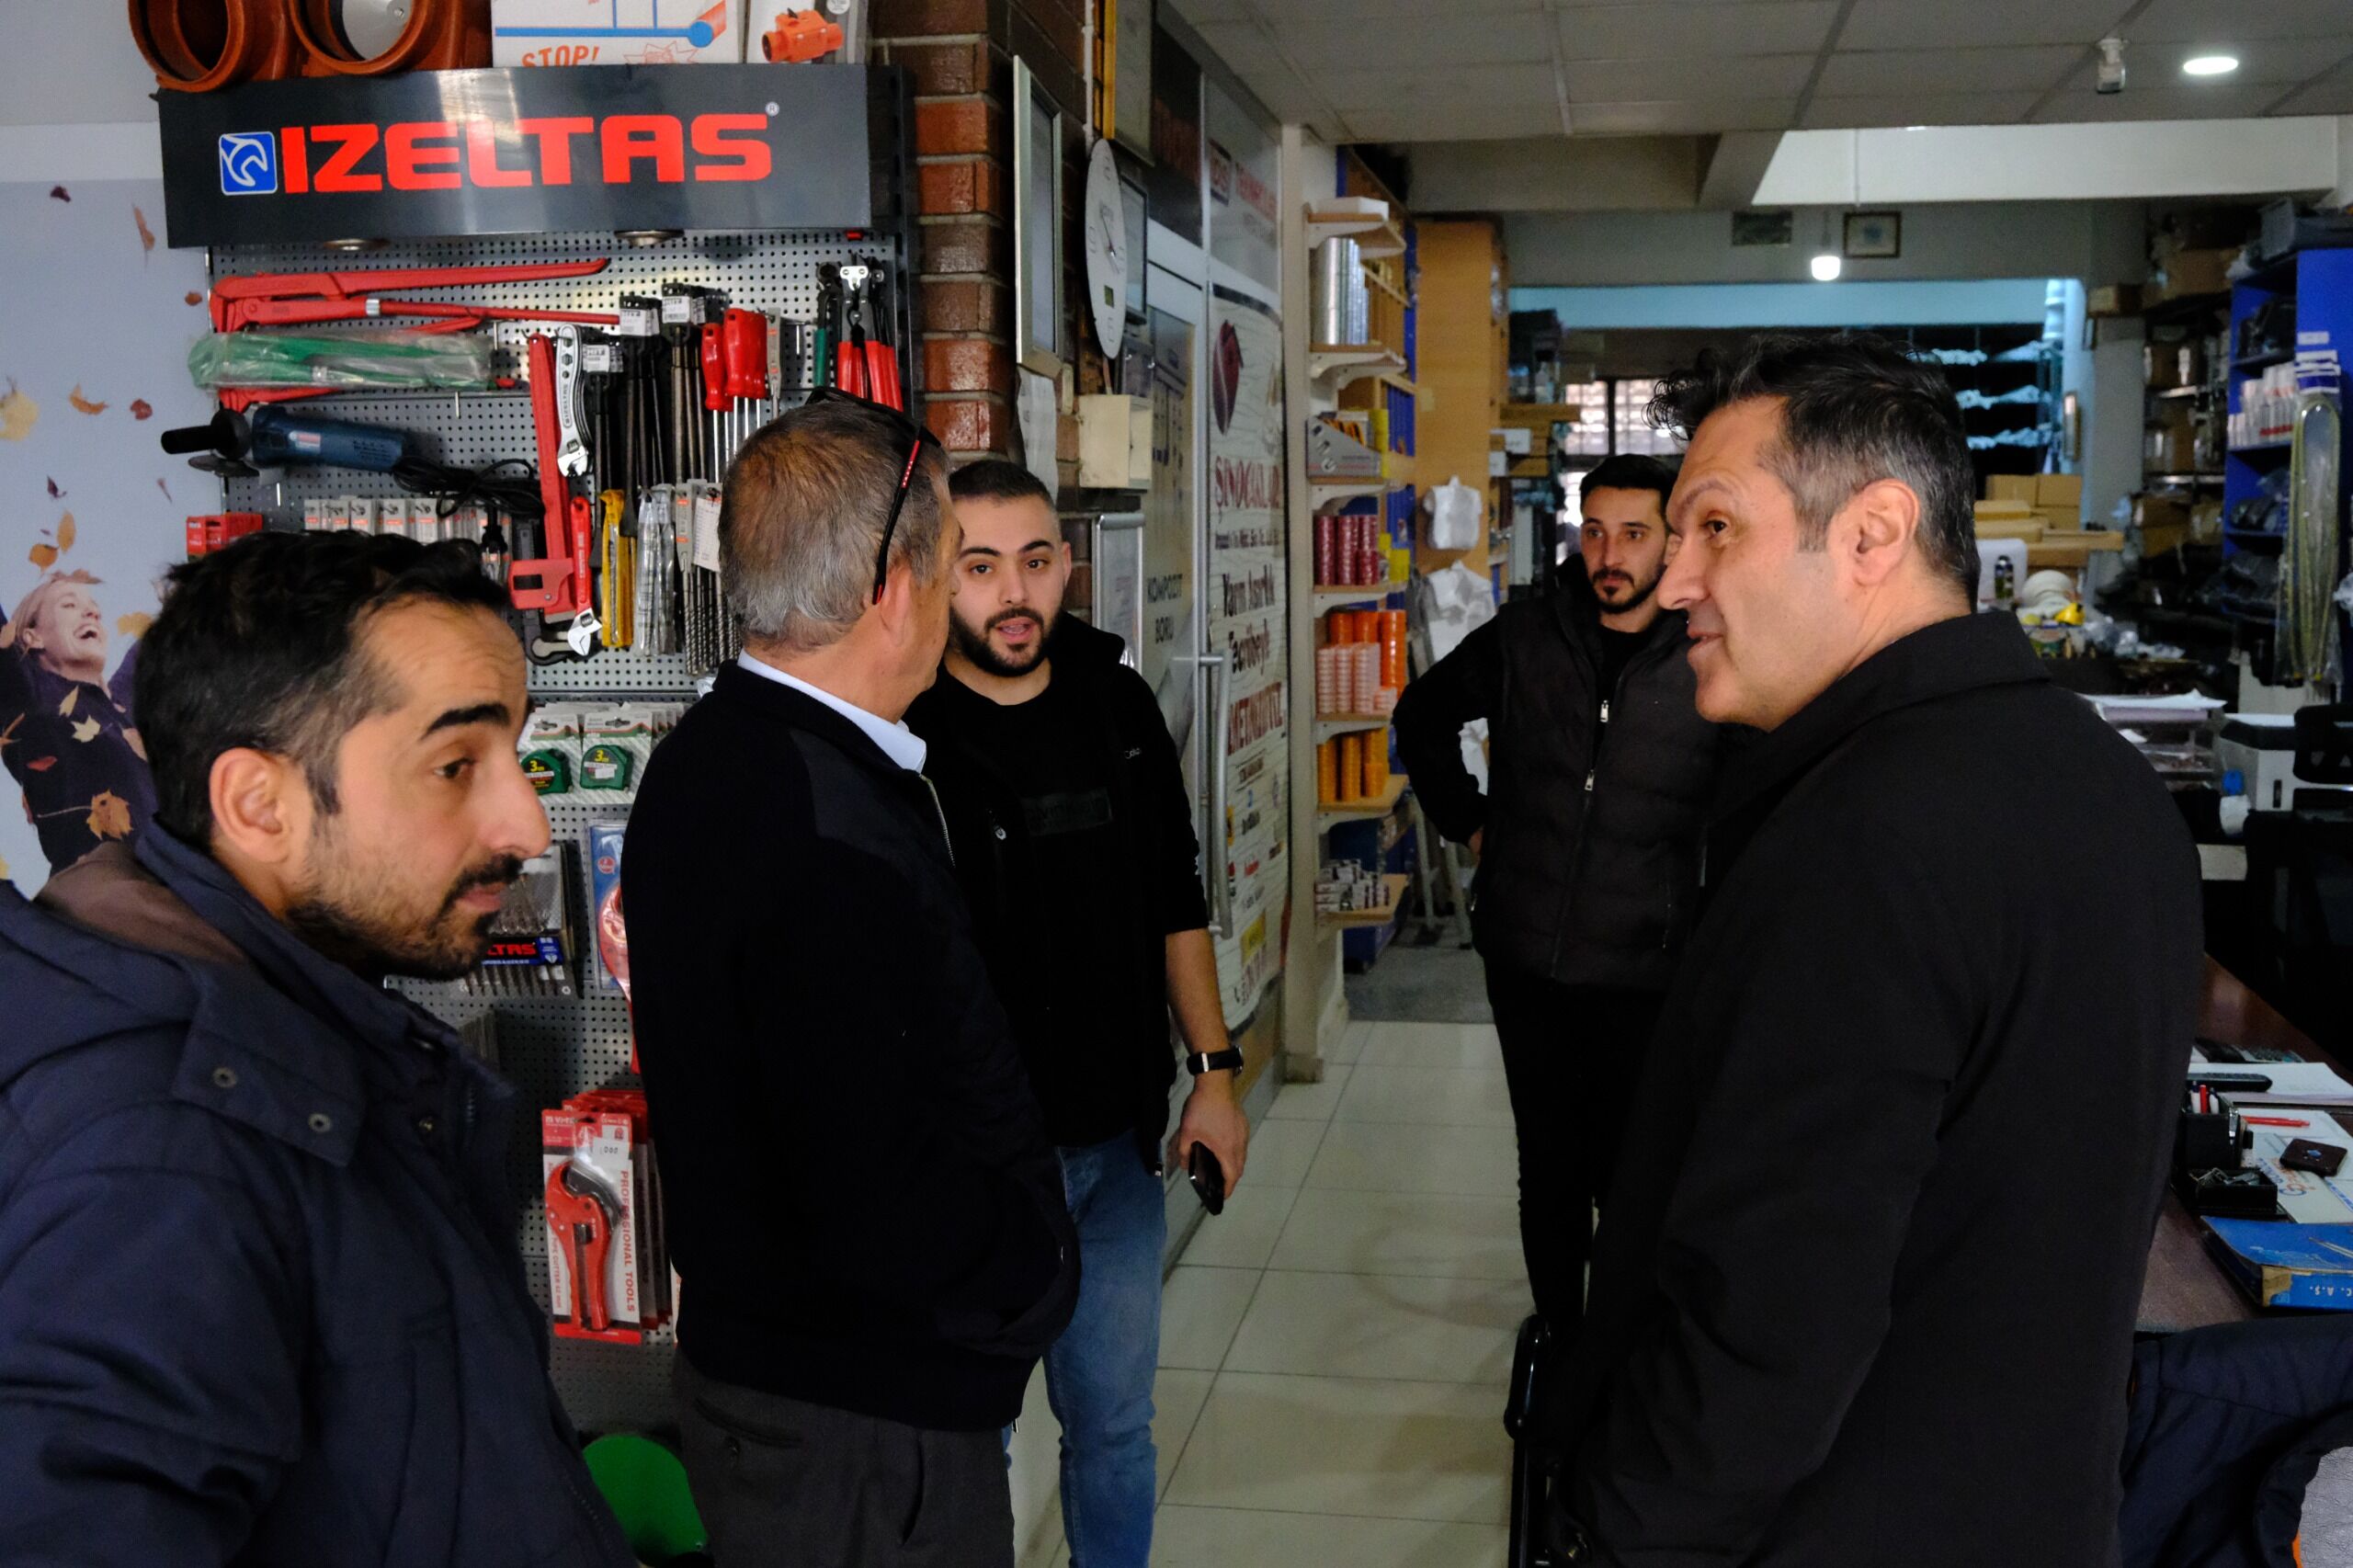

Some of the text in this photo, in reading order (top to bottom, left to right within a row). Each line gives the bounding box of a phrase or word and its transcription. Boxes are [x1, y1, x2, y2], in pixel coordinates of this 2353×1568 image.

[521, 44, 601, 68] STOP!
[280, 113, 772, 193] IZELTAS
[620, 1170, 635, 1312] PROFESSIONAL TOOLS
